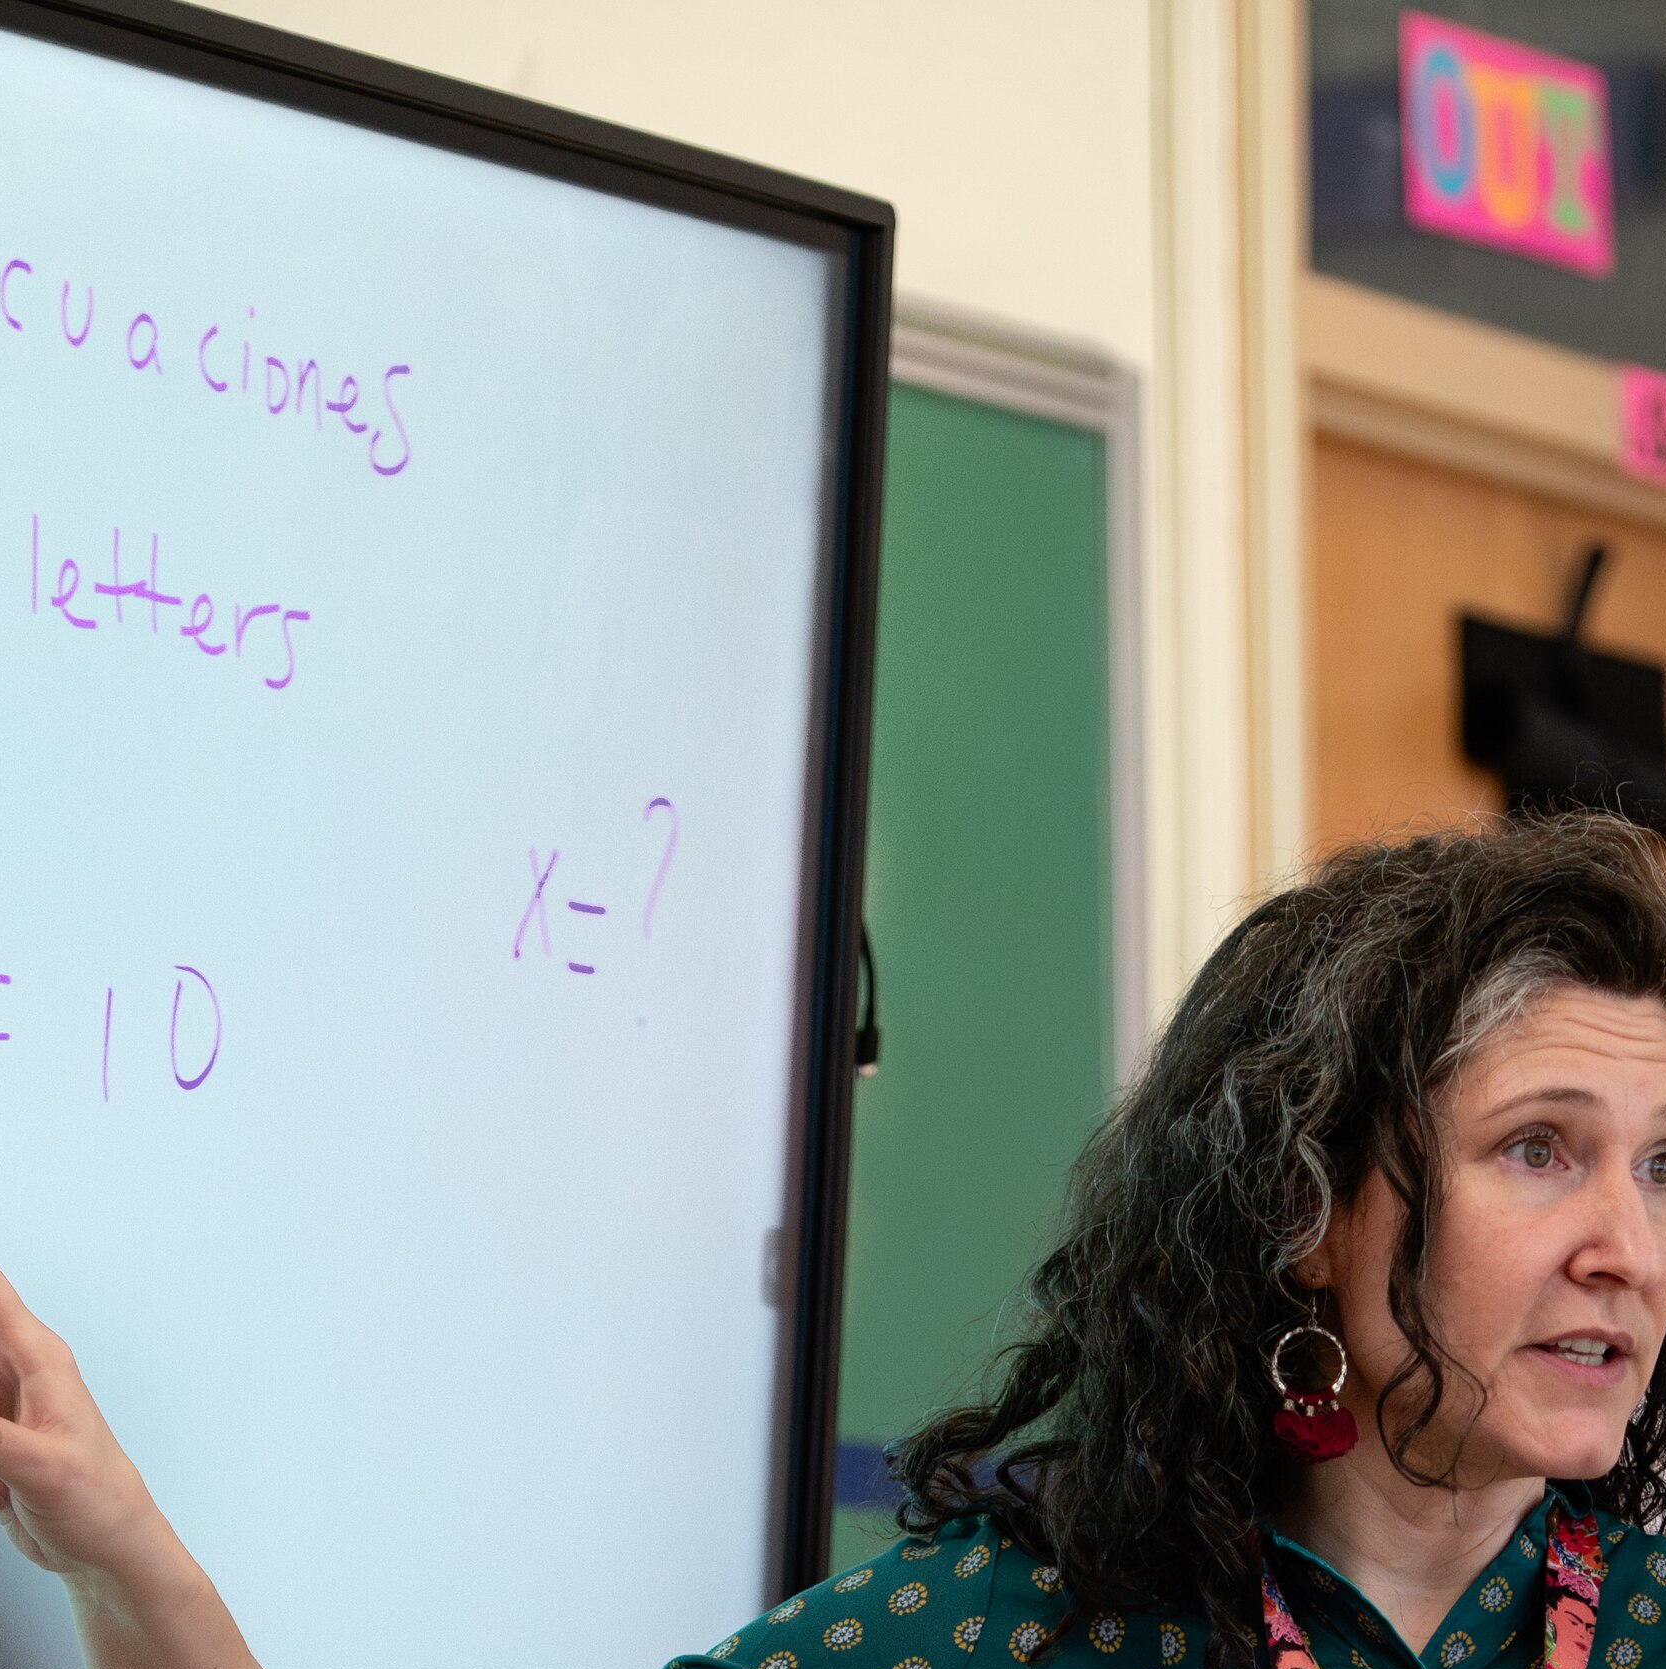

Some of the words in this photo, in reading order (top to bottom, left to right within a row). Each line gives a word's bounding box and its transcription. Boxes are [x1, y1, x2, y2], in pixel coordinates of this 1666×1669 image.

[1413, 44, 1604, 236] OUT
[29, 513, 312, 691] letters
[101, 964, 222, 1103] 10
